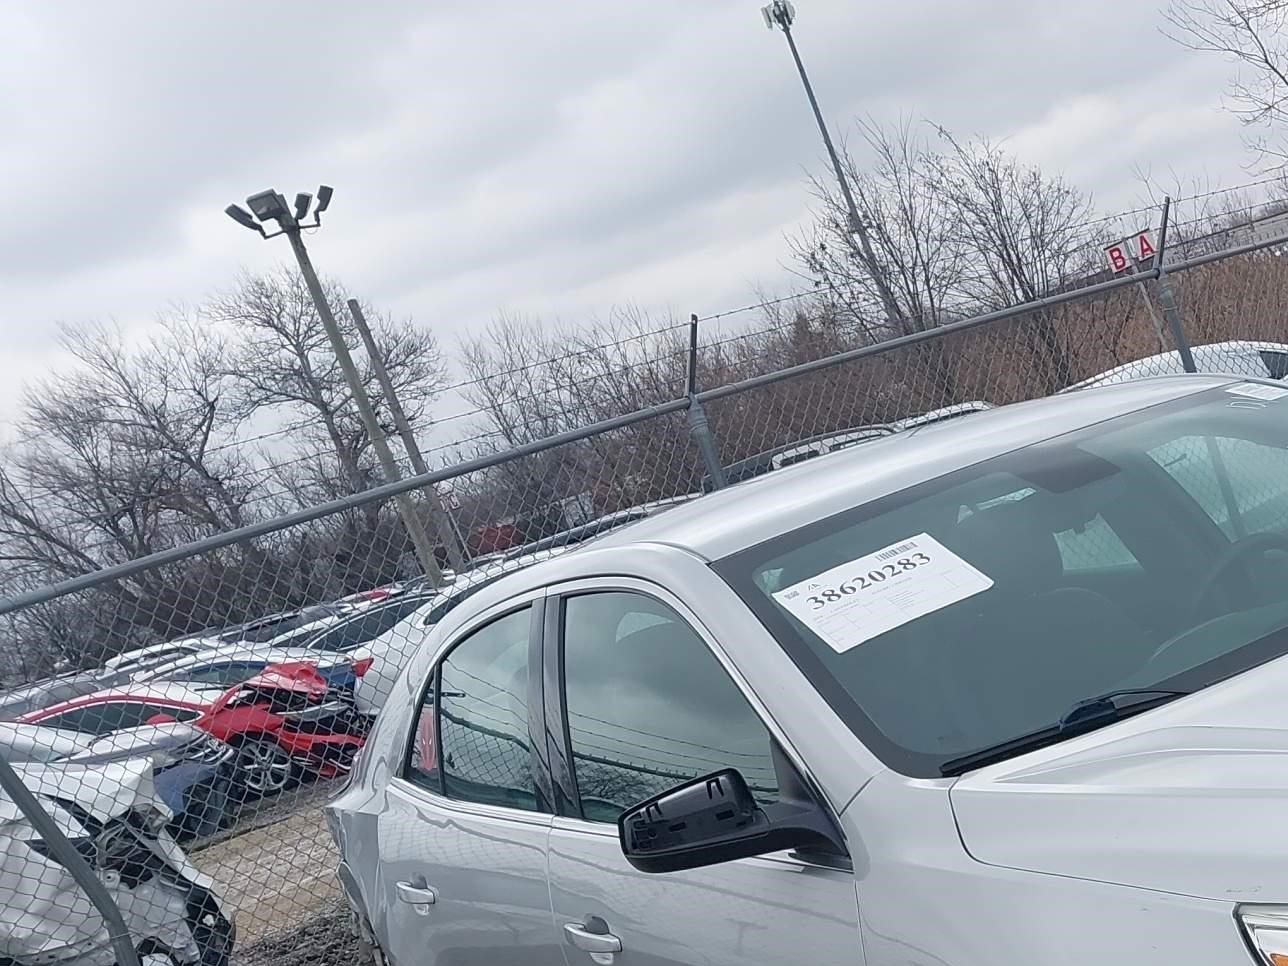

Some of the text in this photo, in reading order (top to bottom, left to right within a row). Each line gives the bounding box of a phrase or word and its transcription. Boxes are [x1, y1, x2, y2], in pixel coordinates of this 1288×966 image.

[1109, 234, 1156, 271] B A
[806, 552, 931, 610] 38620283
